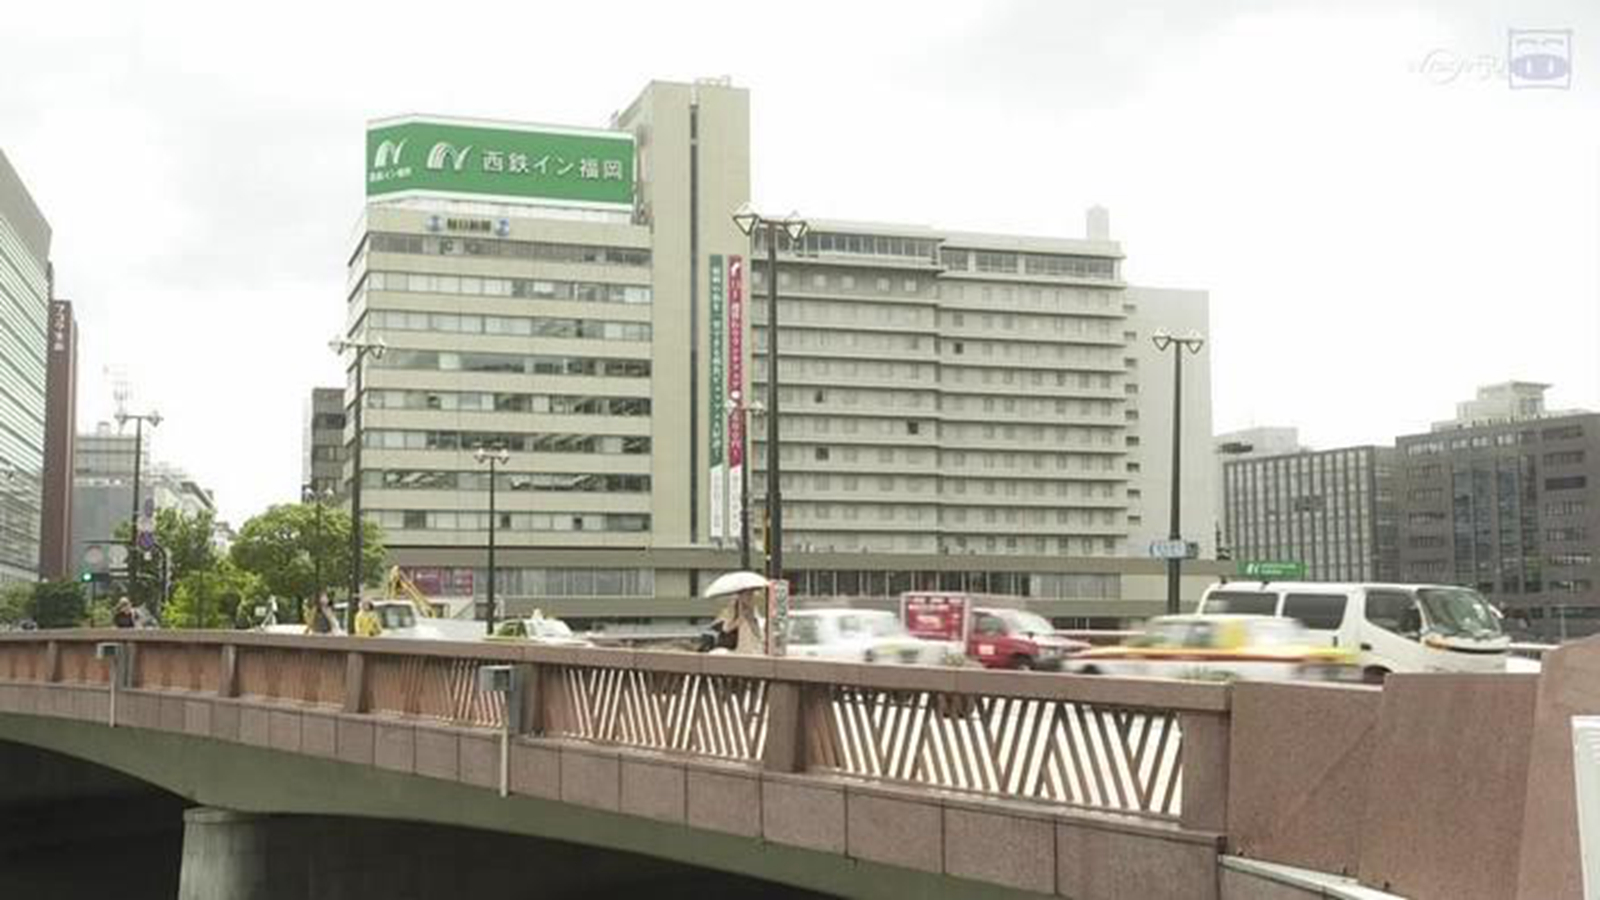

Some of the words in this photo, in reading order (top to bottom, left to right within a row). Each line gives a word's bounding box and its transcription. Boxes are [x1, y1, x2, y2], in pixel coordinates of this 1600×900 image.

[482, 152, 623, 180] 西鉄イン福岡
